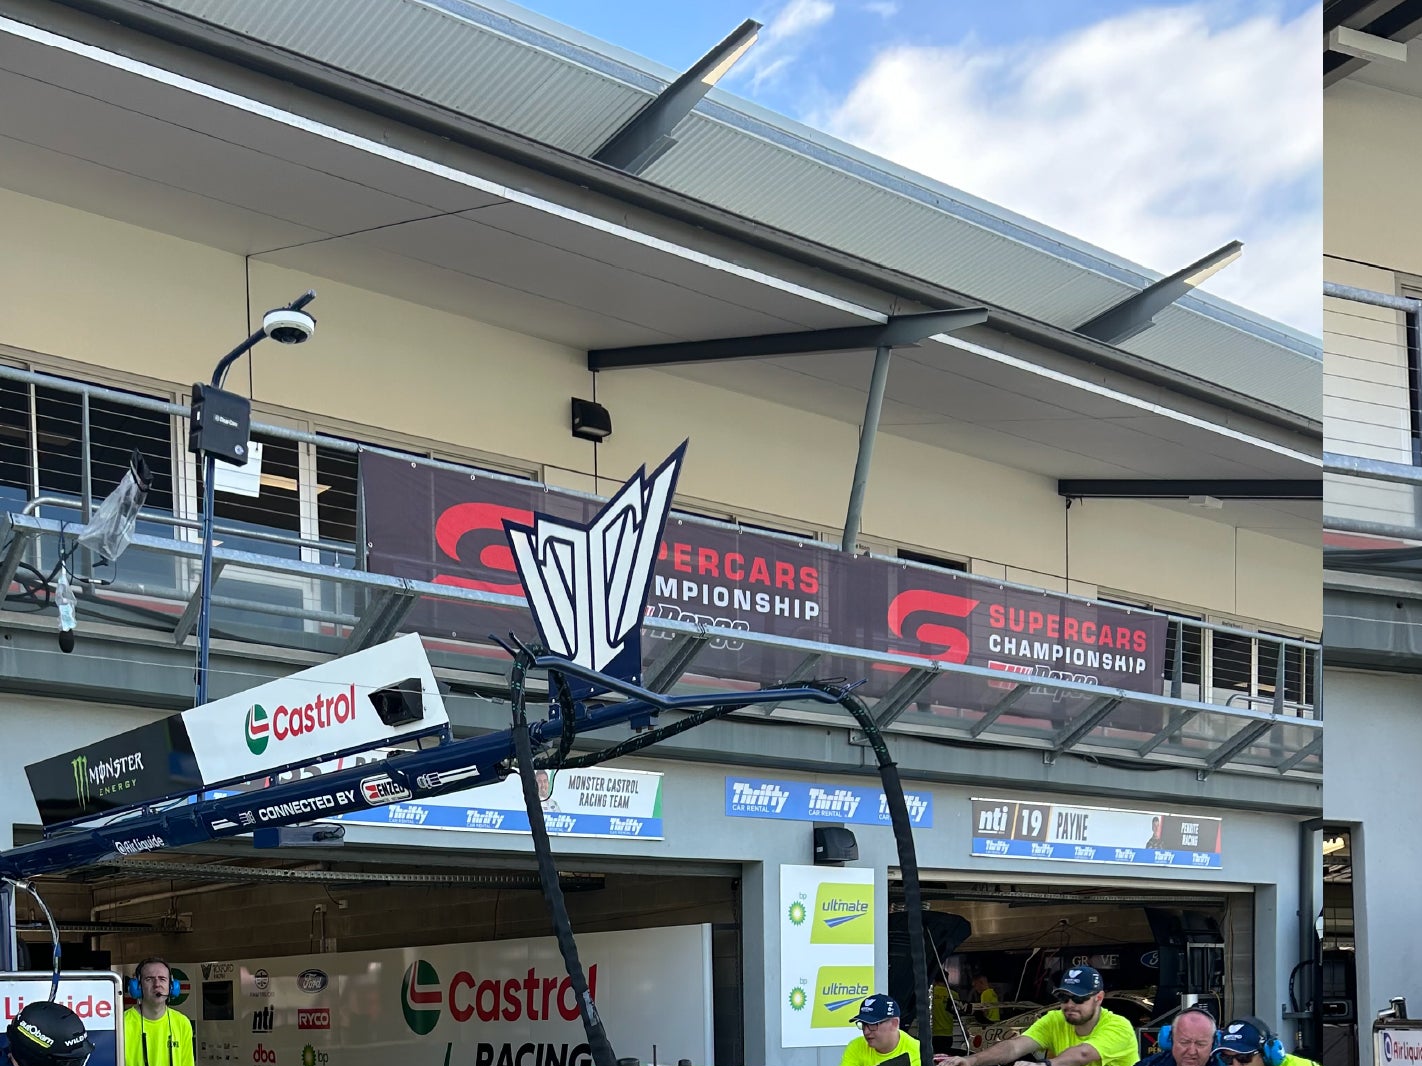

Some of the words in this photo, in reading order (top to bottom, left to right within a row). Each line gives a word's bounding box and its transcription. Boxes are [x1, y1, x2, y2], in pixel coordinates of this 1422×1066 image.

[988, 603, 1147, 652] SUPERCARS
[988, 633, 1147, 675] CHAMPIONSHIP
[272, 683, 356, 741] Castrol
[89, 753, 144, 785] MONSTER
[99, 779, 137, 797] ENERGY
[568, 775, 604, 791] MONSTER
[606, 777, 639, 794] CASTROL
[258, 795, 335, 822] CONNECTED
[338, 789, 355, 804] BY
[579, 792, 607, 807] RACING
[609, 794, 630, 809] TEAM
[732, 782, 789, 813] Thrifty
[808, 788, 860, 817] Thrifty
[388, 804, 429, 824] Thrifty
[466, 809, 504, 829] Thrifty
[747, 805, 770, 813] RENTAL
[821, 810, 842, 818] RENTAL
[978, 806, 1008, 831] nti
[609, 817, 643, 835] Thrifty
[1021, 810, 1042, 837] 19
[1056, 812, 1088, 841] PAYNE
[822, 899, 868, 912] ultimate
[822, 983, 868, 996] ultimate
[253, 1004, 275, 1030] nti
[299, 1012, 330, 1026] RYCO
[253, 1043, 276, 1064] dba
[317, 1051, 329, 1066] bp
